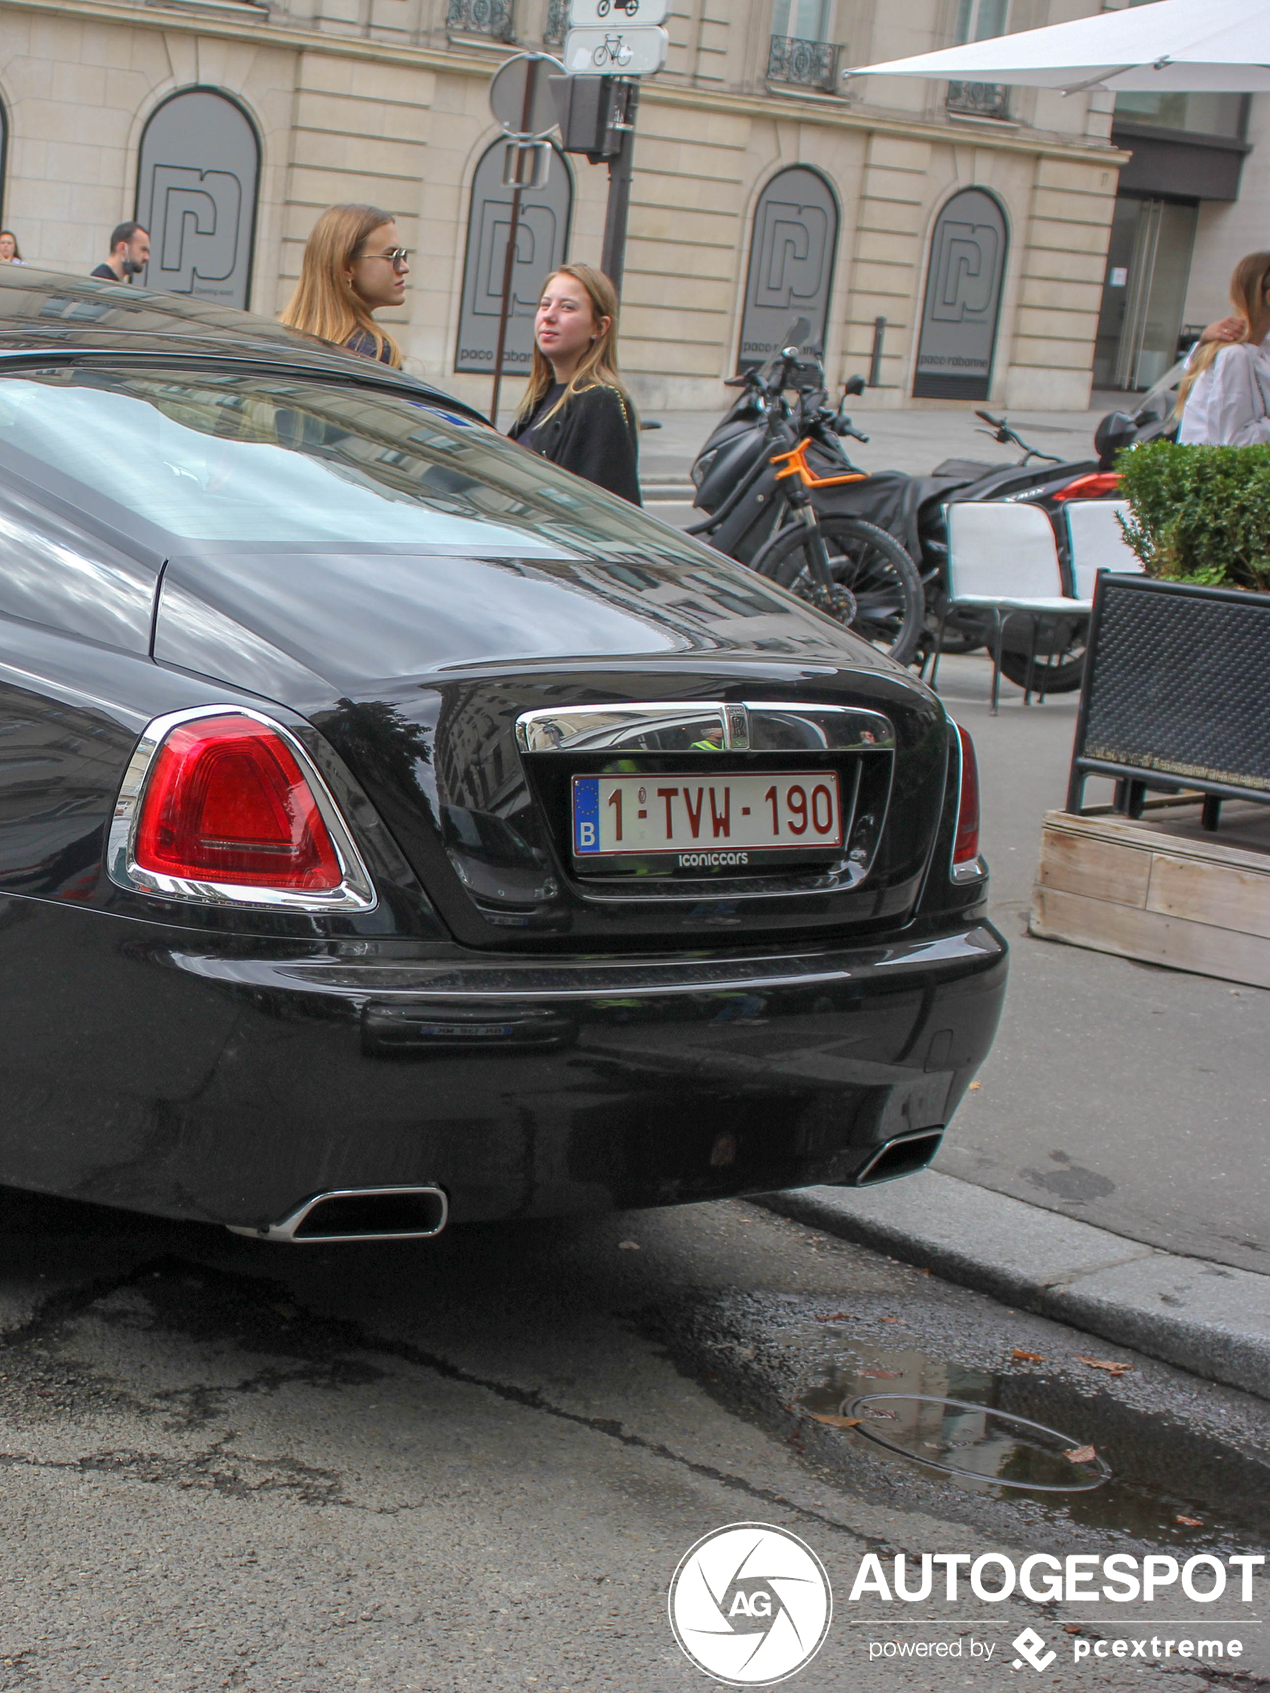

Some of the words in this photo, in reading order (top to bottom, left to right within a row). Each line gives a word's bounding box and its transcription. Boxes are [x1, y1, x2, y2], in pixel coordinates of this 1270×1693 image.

[461, 349, 494, 360] paco
[743, 342, 771, 353] paco
[920, 354, 945, 365] paco
[947, 355, 988, 368] rabanne
[608, 784, 833, 841] 1-TVW-190
[580, 822, 596, 846] B
